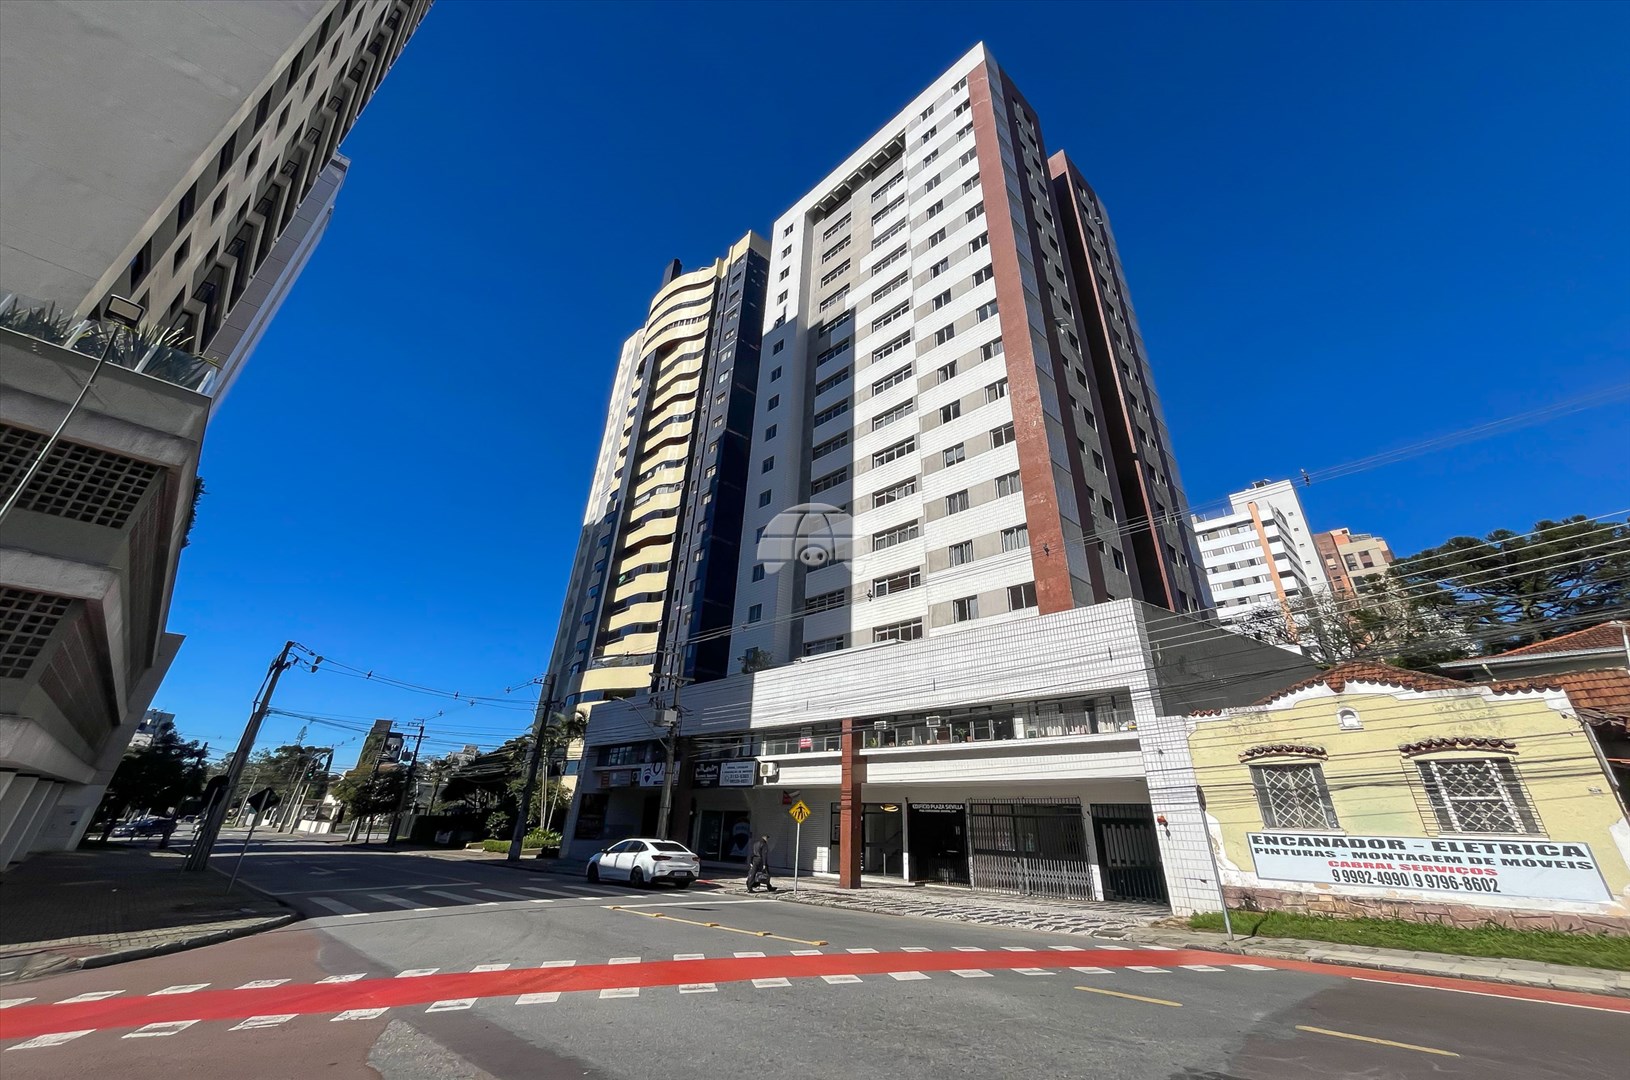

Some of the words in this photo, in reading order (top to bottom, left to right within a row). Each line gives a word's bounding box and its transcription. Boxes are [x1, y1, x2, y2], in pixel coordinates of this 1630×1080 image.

[1251, 835, 1407, 850] ENCANADOR
[1431, 841, 1588, 858] ELETRICA
[1254, 847, 1337, 858] PINTURAS
[1351, 851, 1463, 864] MONTAGEM
[1469, 857, 1496, 866] DE
[1500, 858, 1594, 870] MÓVEIS
[1327, 860, 1396, 870] CABRAL
[1399, 863, 1499, 876] SERVIÇOS
[1331, 868, 1341, 883] 9
[1341, 870, 1410, 887] 9992-4990
[1413, 873, 1424, 888] 9
[1425, 875, 1501, 893] 9796-8602
